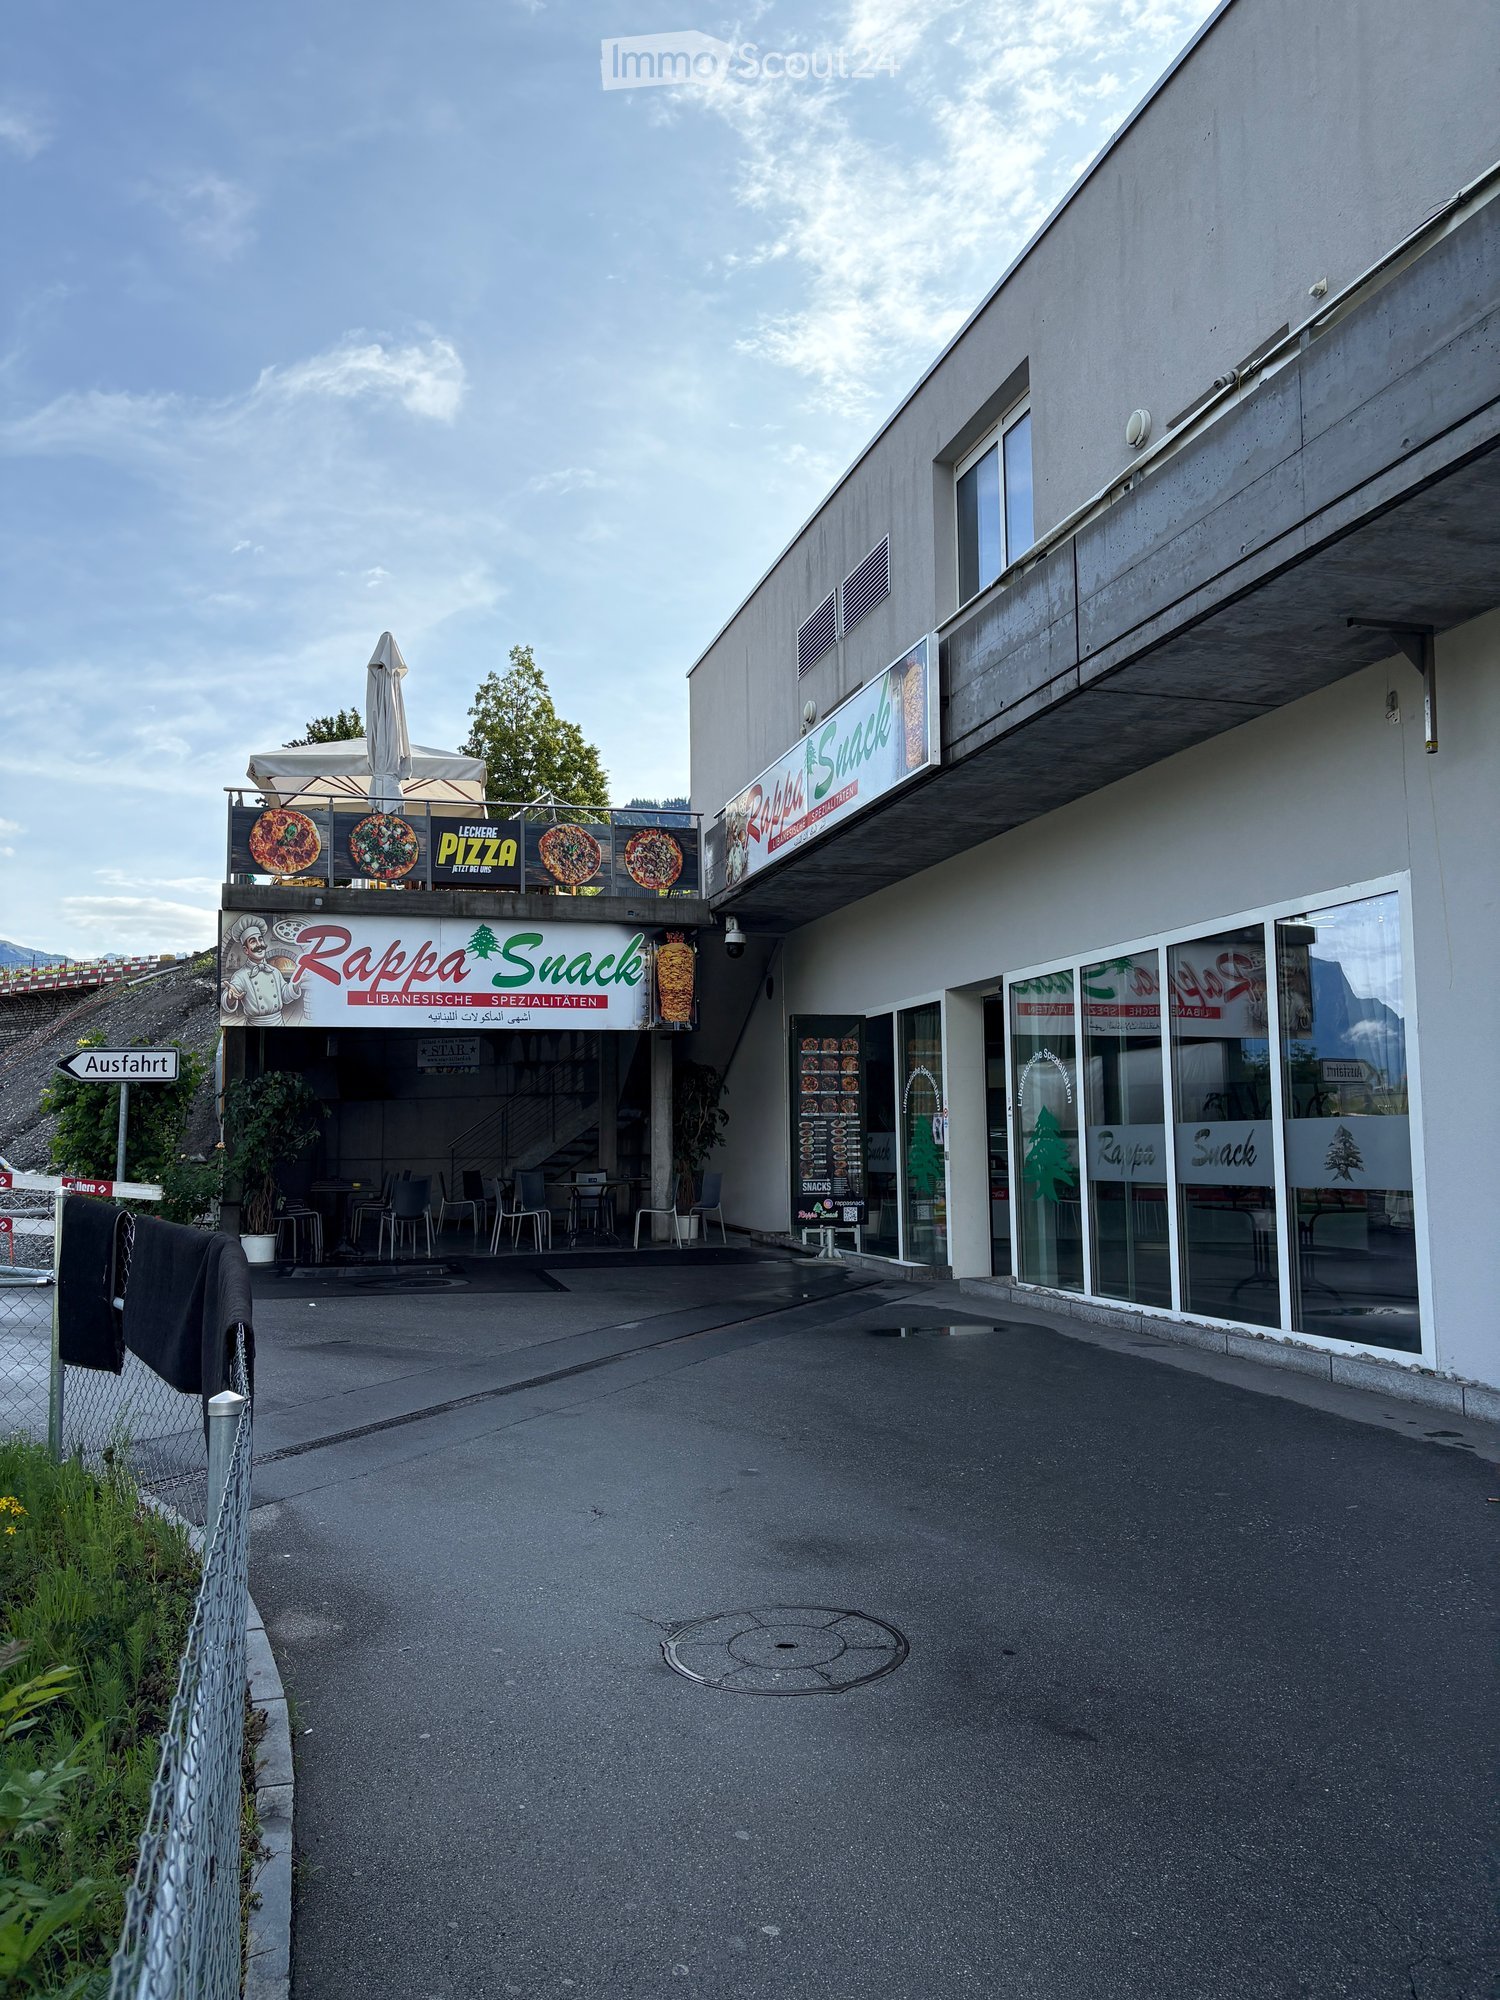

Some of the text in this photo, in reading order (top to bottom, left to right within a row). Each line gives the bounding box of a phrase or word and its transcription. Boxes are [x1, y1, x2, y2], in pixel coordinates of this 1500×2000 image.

[746, 671, 892, 849] Rappa Snack
[772, 818, 806, 849] LIBANESISCHE
[811, 785, 855, 822] SPEZIALITÄTEN
[458, 825, 499, 838] LECKERE
[437, 832, 518, 867] PIZZA
[451, 865, 469, 874] JETZT
[292, 924, 645, 993] Rappa Snack
[366, 992, 598, 1008] LIBANESISCHE SPEZIALITÄTEN
[431, 1044, 464, 1056] STAR
[85, 1054, 168, 1073] Ausfahrt
[1096, 1128, 1257, 1175] Rappa Snack
[802, 1182, 832, 1192] SNACKS
